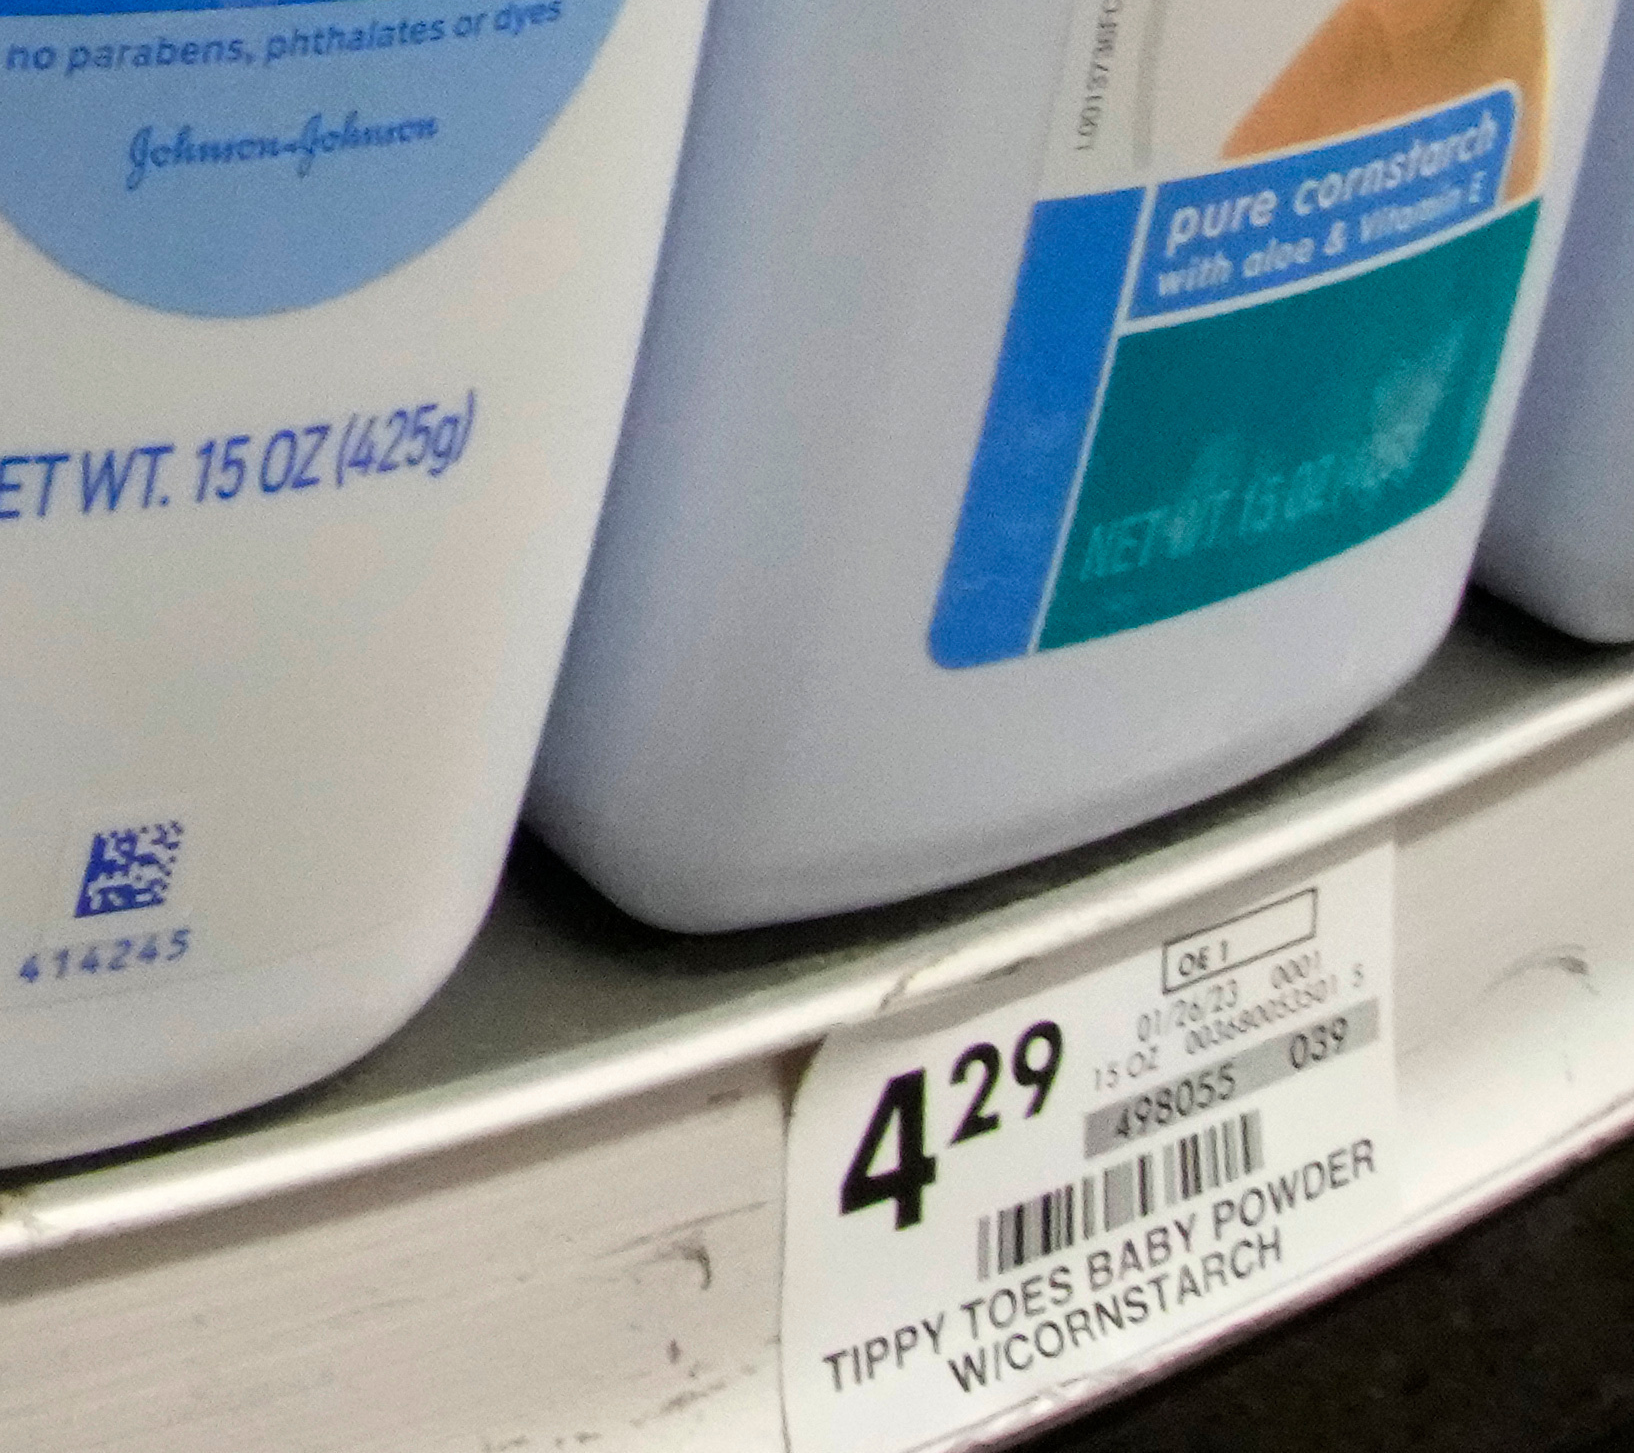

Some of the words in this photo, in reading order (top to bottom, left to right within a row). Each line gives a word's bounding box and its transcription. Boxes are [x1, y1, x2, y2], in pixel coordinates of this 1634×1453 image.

[65, 34, 255, 76] parabens,
[265, 19, 446, 66] phthalates
[1159, 251, 1233, 294] with
[1243, 236, 1315, 277] aloe
[1324, 221, 1347, 255] &
[1468, 170, 1487, 203] E
[1165, 189, 1278, 258] pure
[1293, 109, 1497, 215] cornstarch
[80, 443, 175, 516] WT.
[195, 434, 250, 504] 15
[260, 424, 333, 494] OZ
[335, 387, 476, 488] (425g)
[19, 928, 191, 984] 414245
[1135, 979, 1240, 1044] 01/26/23
[1270, 949, 1323, 990] 0001
[1178, 946, 1211, 979] OE
[1114, 1063, 1238, 1141] 498055
[1287, 1016, 1350, 1072] 039
[1124, 1048, 1160, 1081] OZ
[822, 1313, 949, 1394] TIPPY
[959, 1275, 1073, 1340] TOES
[1086, 1213, 1199, 1295] BABY
[1211, 1136, 1379, 1232] POWDER
[947, 1227, 1285, 1395] W/CORNSTARCH
